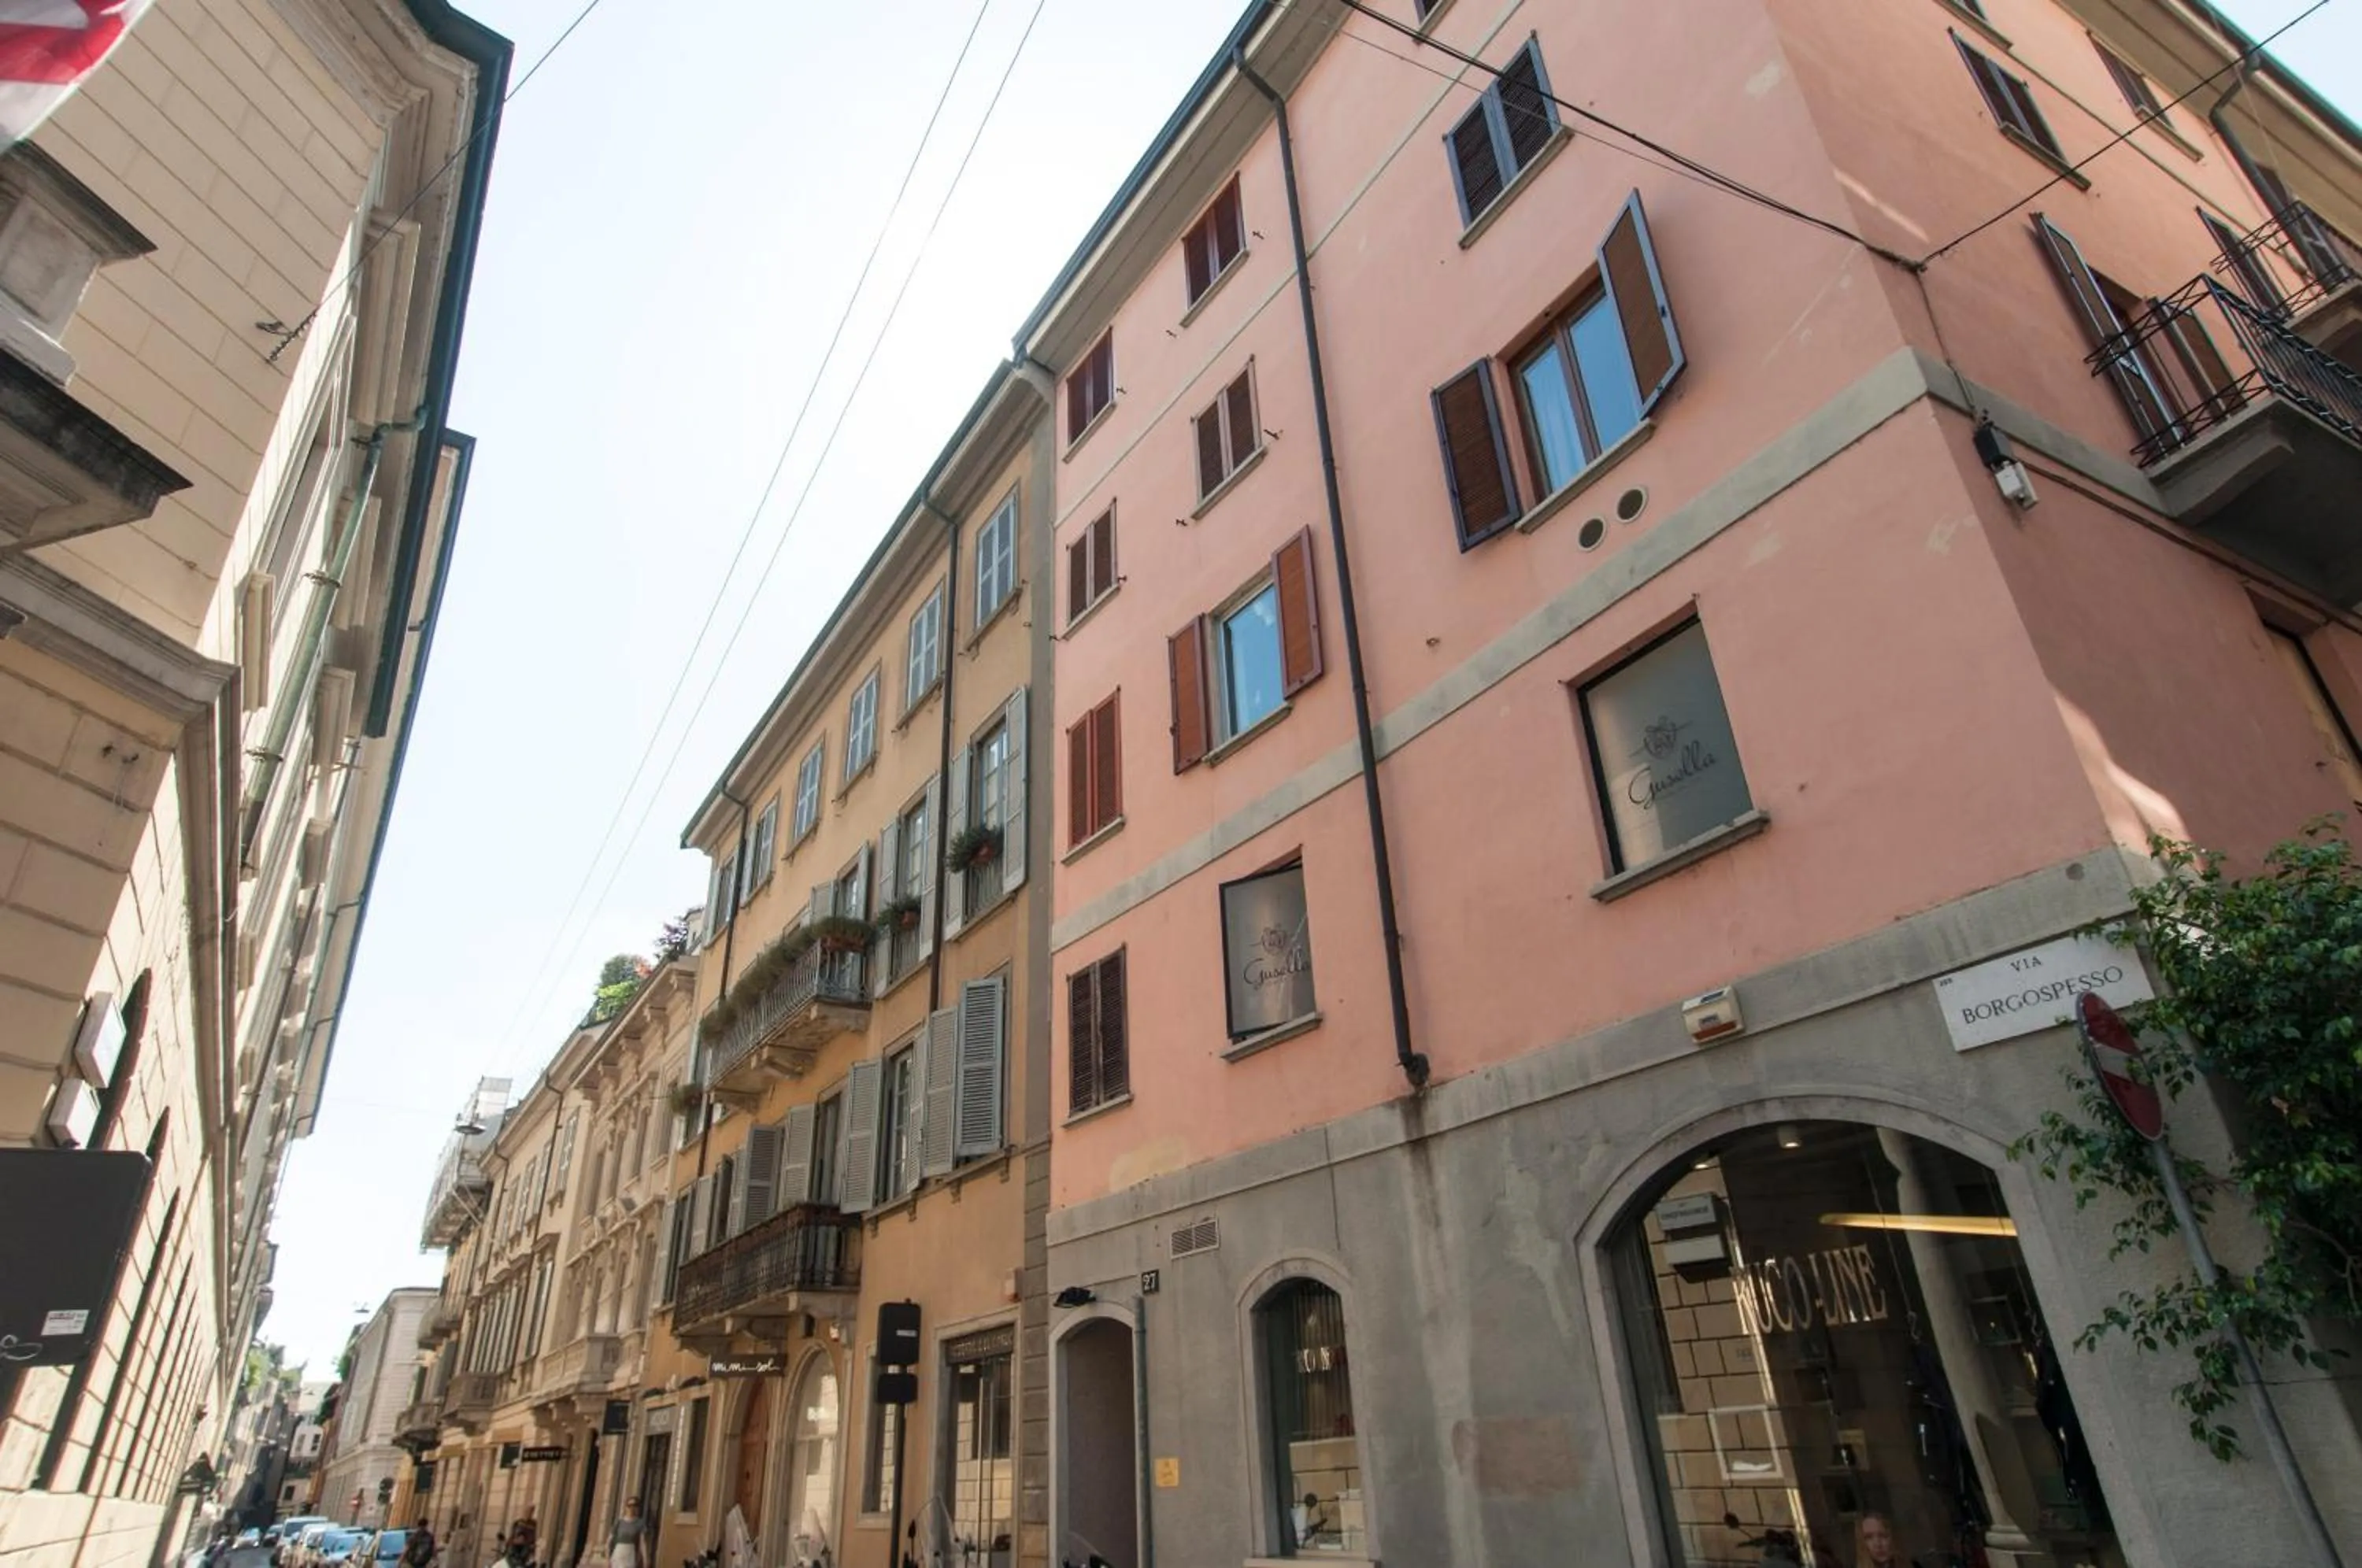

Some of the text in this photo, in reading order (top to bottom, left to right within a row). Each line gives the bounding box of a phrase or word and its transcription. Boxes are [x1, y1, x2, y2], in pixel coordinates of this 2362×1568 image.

[1627, 738, 1717, 810] Gusella
[2009, 955, 2043, 973] VIA
[1962, 965, 2123, 1025] BORGOSPESSO
[1142, 1271, 1157, 1291] 27
